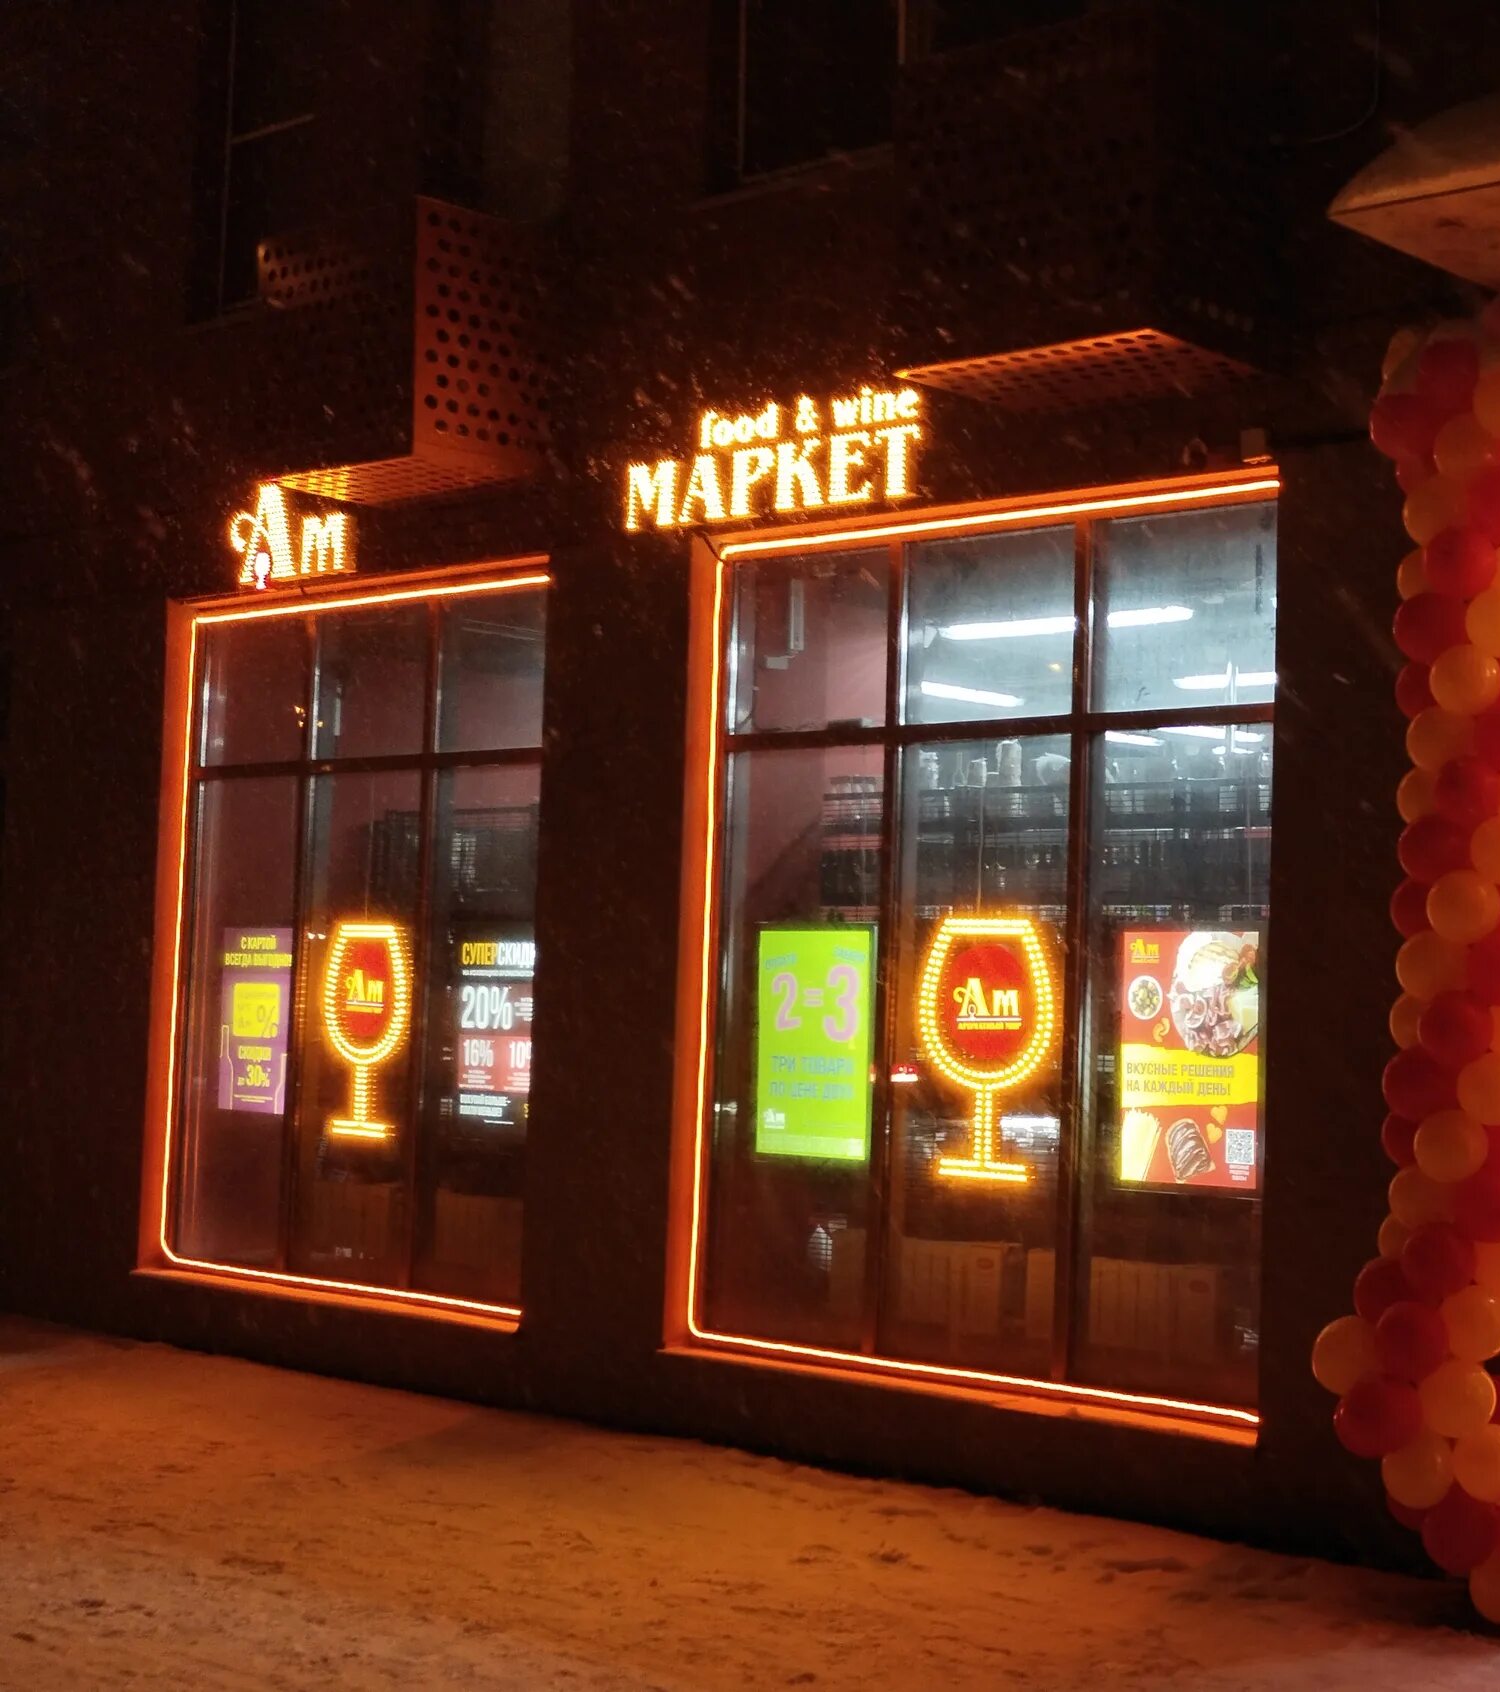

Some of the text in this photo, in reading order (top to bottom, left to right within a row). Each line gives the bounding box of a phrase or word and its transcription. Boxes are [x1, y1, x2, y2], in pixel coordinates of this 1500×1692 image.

[699, 385, 919, 449] food & wine
[624, 423, 921, 530] МАРКЕТ
[461, 986, 513, 1030] 20%
[464, 1039, 494, 1067] 16%
[1126, 1062, 1234, 1079] ВКУСНЫЕ РЕШЕНИЯ
[1126, 1078, 1231, 1096] НА КАЖДЫЙ ДЕНЬ!
